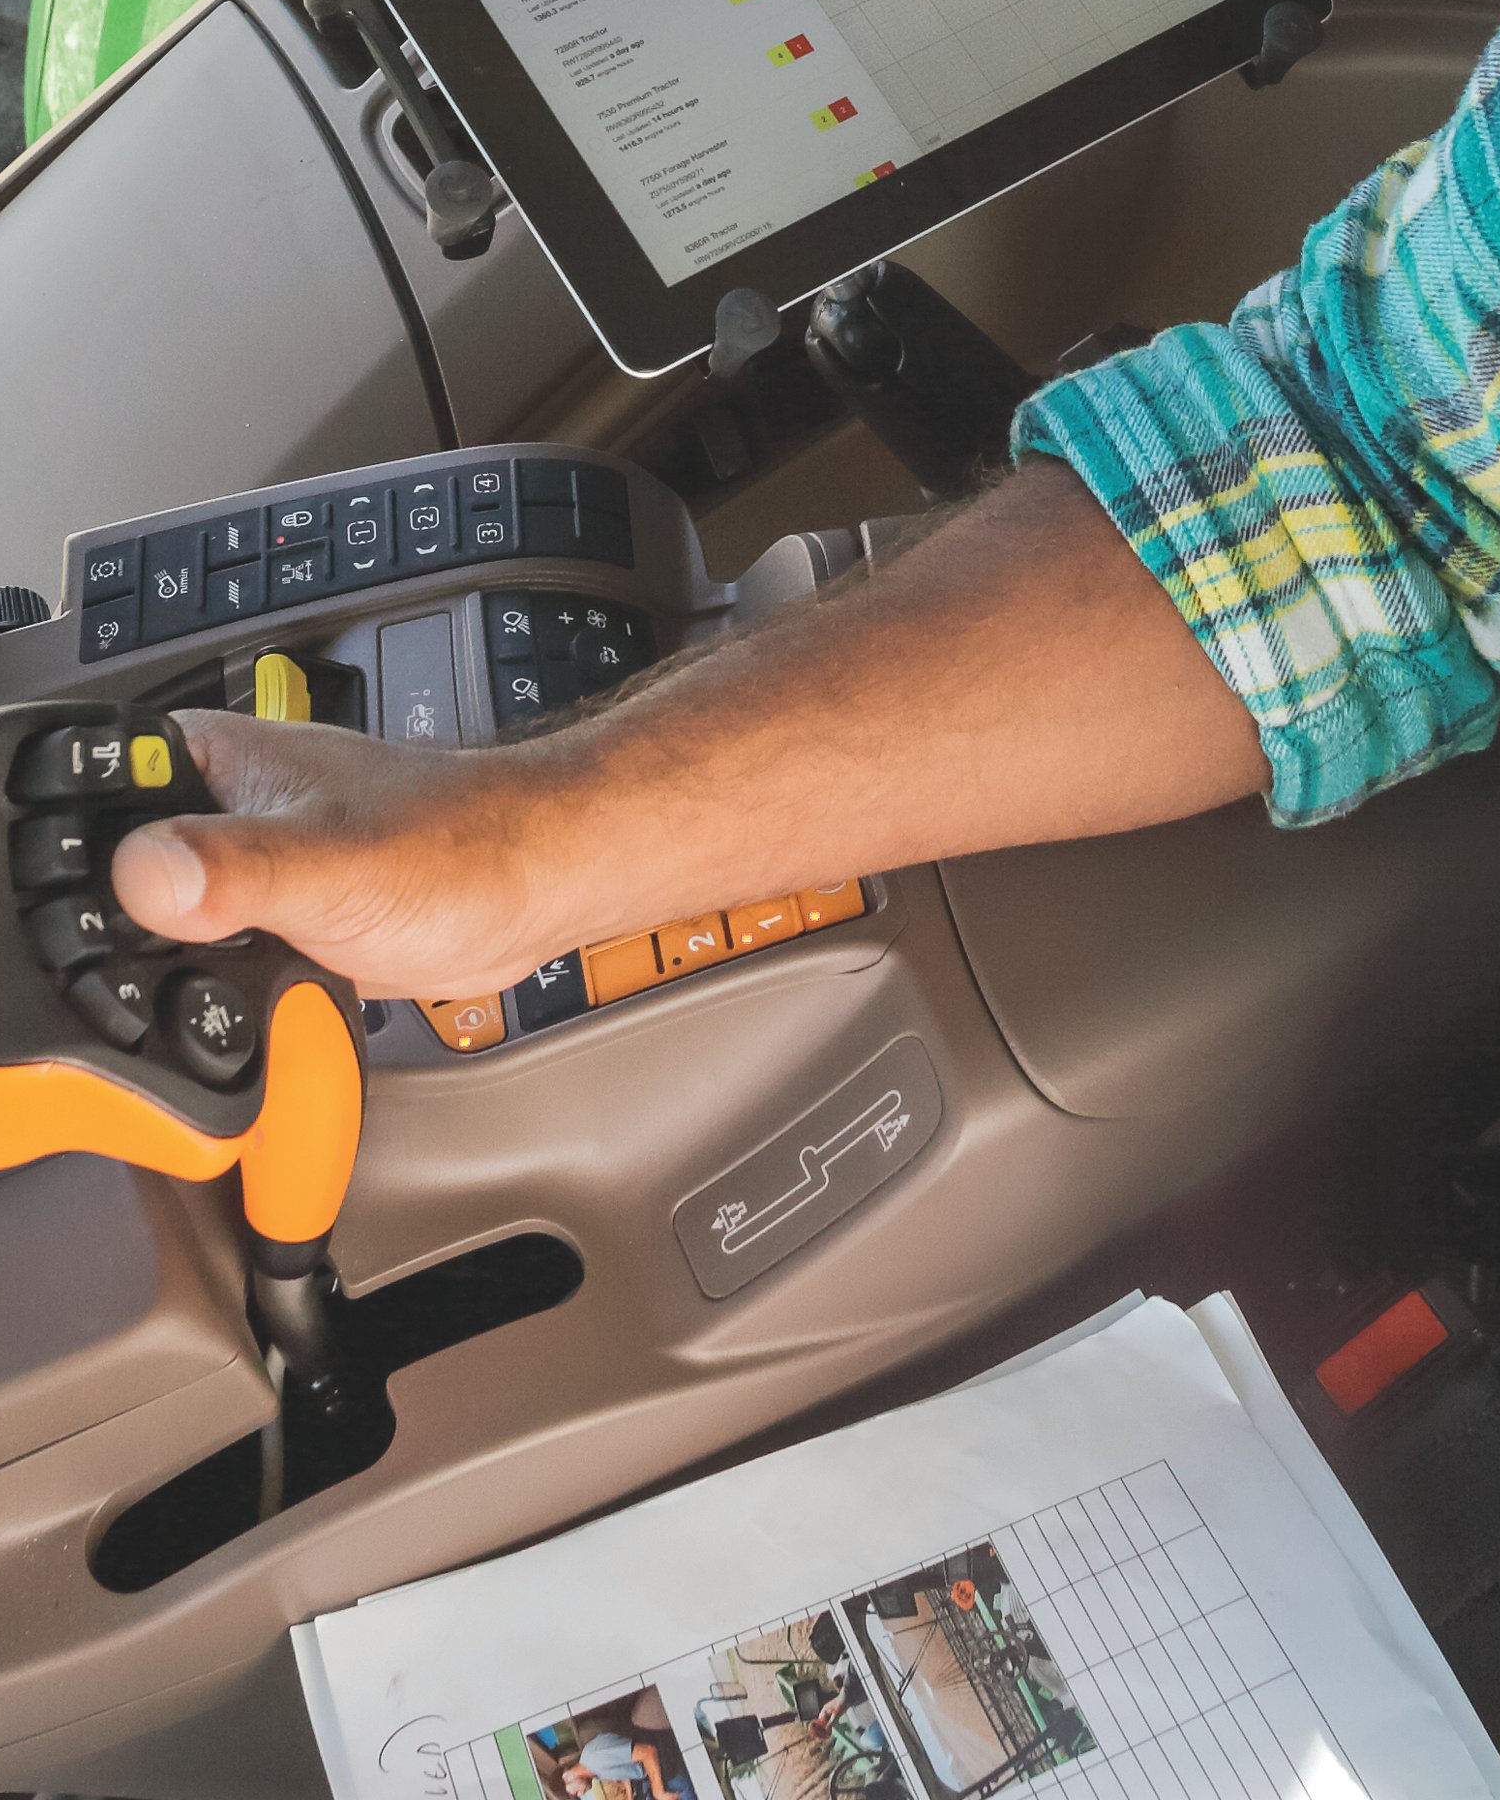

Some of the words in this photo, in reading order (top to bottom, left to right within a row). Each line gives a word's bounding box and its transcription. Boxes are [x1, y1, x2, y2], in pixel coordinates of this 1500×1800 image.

[553, 38, 581, 55] 7280R
[579, 25, 609, 44] Tractor
[613, 44, 631, 57] day
[629, 38, 646, 50] ago
[596, 106, 618, 120] 7530
[616, 89, 653, 111] Premium
[651, 76, 680, 94] Tractor
[651, 114, 662, 123] 14
[661, 104, 684, 118] hours
[683, 97, 701, 110] ago
[661, 156, 692, 177] Forage
[689, 138, 729, 162] Harvester
[700, 174, 718, 187] day
[715, 168, 733, 180] ago
[709, 220, 739, 240] Tractor
[180, 567, 189, 594] n/min
[61, 838, 83, 850] 1
[80, 911, 105, 931] 2
[757, 913, 783, 931] 1
[687, 930, 716, 952] 2
[118, 983, 141, 1000] 3
